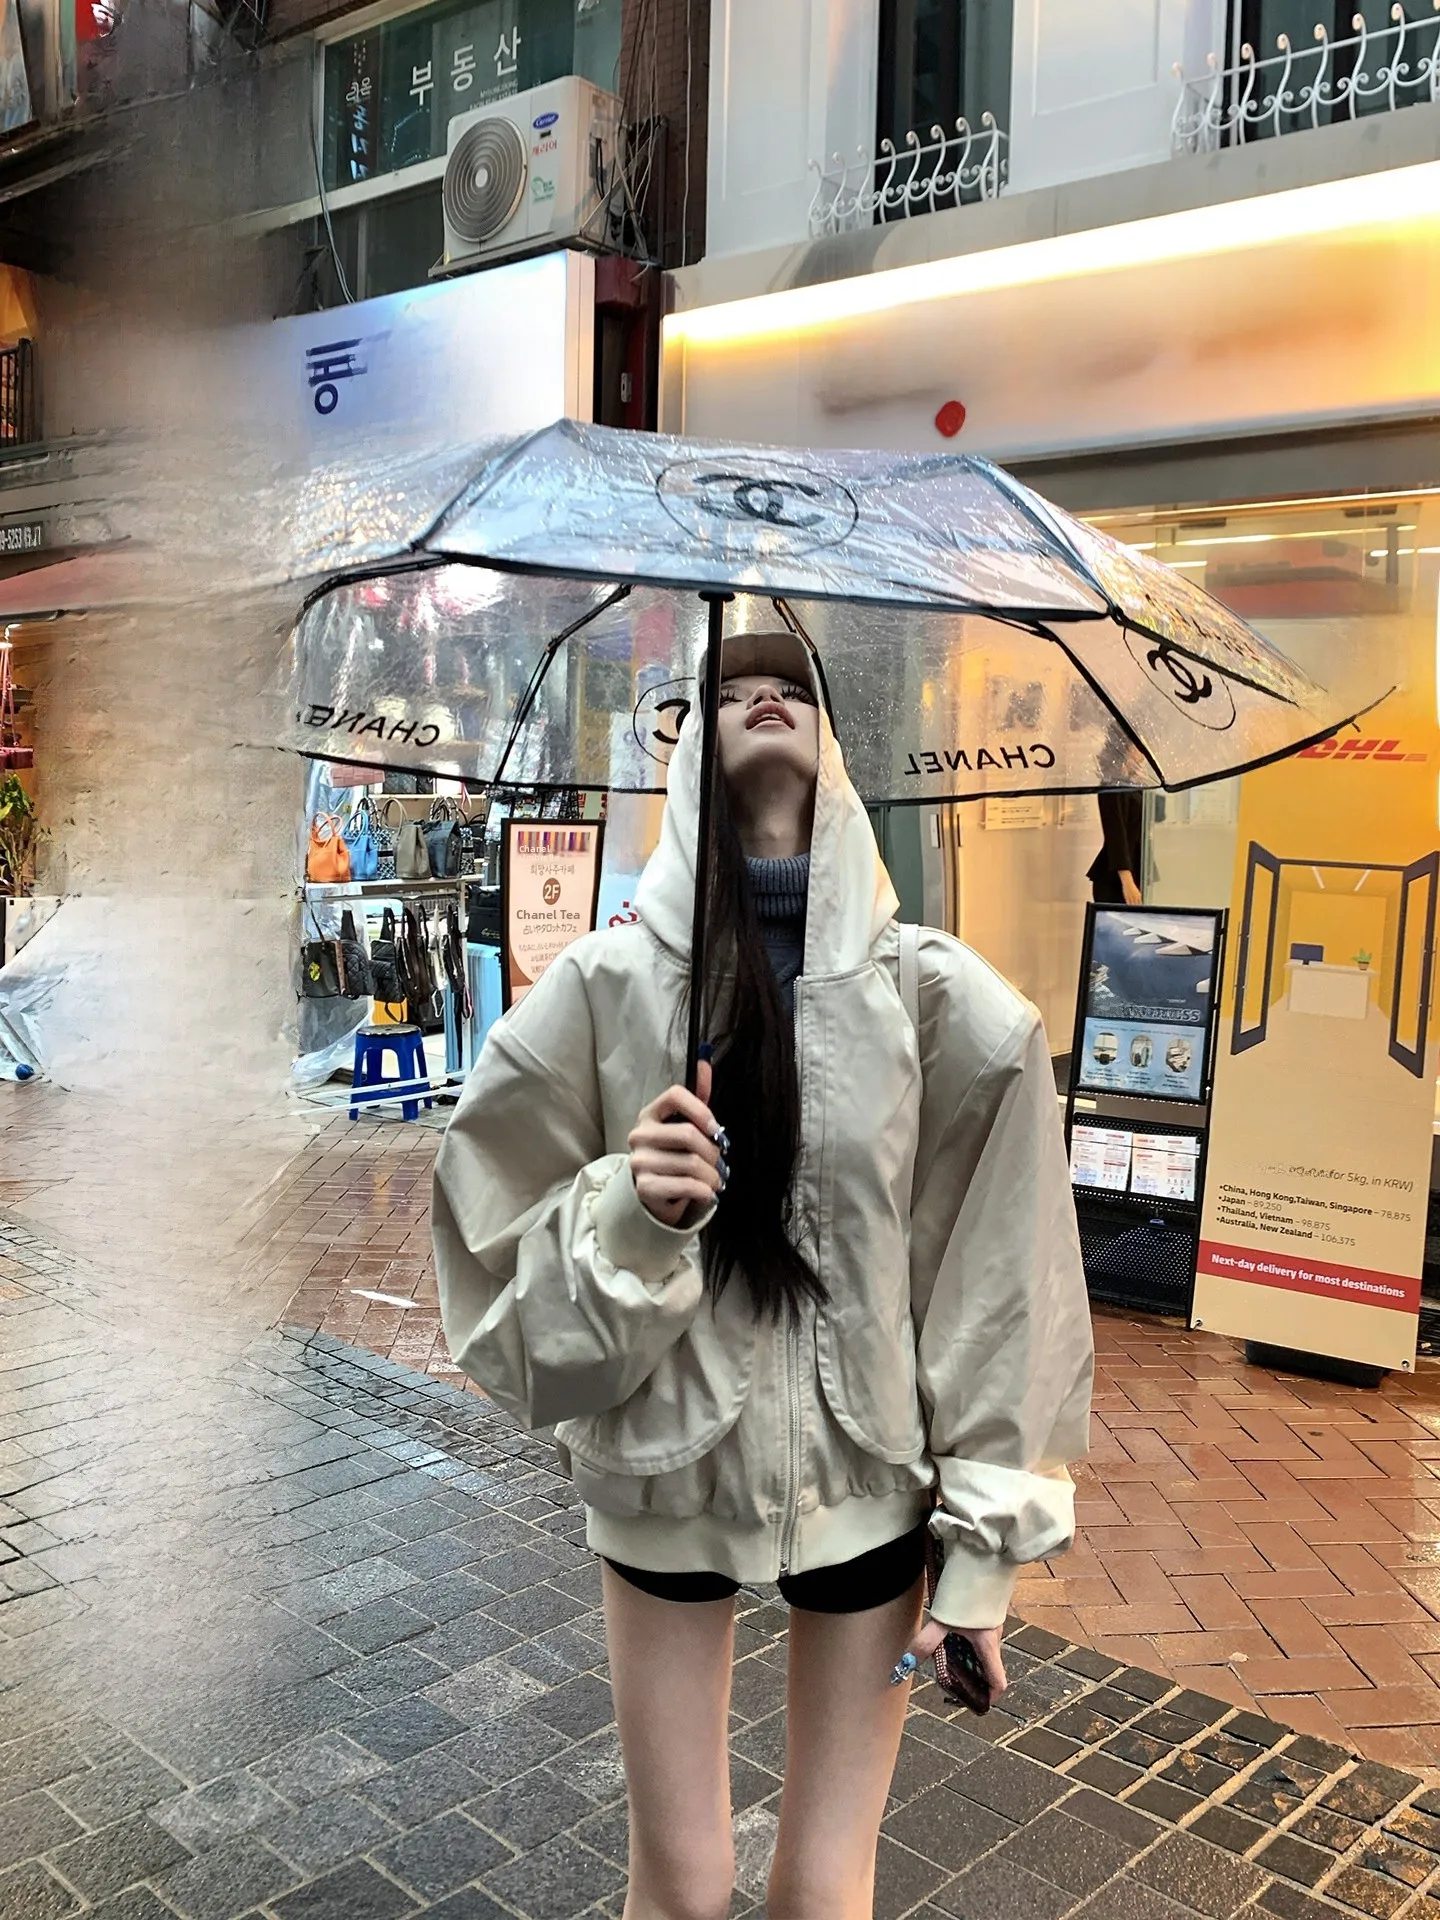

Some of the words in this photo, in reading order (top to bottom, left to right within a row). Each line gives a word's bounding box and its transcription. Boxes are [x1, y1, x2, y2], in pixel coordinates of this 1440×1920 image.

[1296, 739, 1408, 761] DHL
[519, 845, 551, 853] Chanel
[544, 884, 560, 900] 2F
[516, 909, 557, 920] Chanel
[560, 909, 581, 920] Tea
[1371, 1178, 1381, 1186] in
[1383, 1178, 1414, 1193] KRW)
[1221, 1195, 1246, 1205] Japan
[1249, 1189, 1271, 1200] Hong
[1329, 1201, 1373, 1216] Singapore
[1259, 1212, 1294, 1225] Vietnam
[1260, 1223, 1279, 1233] New
[1280, 1226, 1313, 1239] Zealand
[1211, 1253, 1256, 1272] Next-day
[1256, 1262, 1297, 1280] delivery
[1298, 1269, 1314, 1281] for
[1314, 1273, 1341, 1287] most
[1341, 1278, 1405, 1298] destinations
